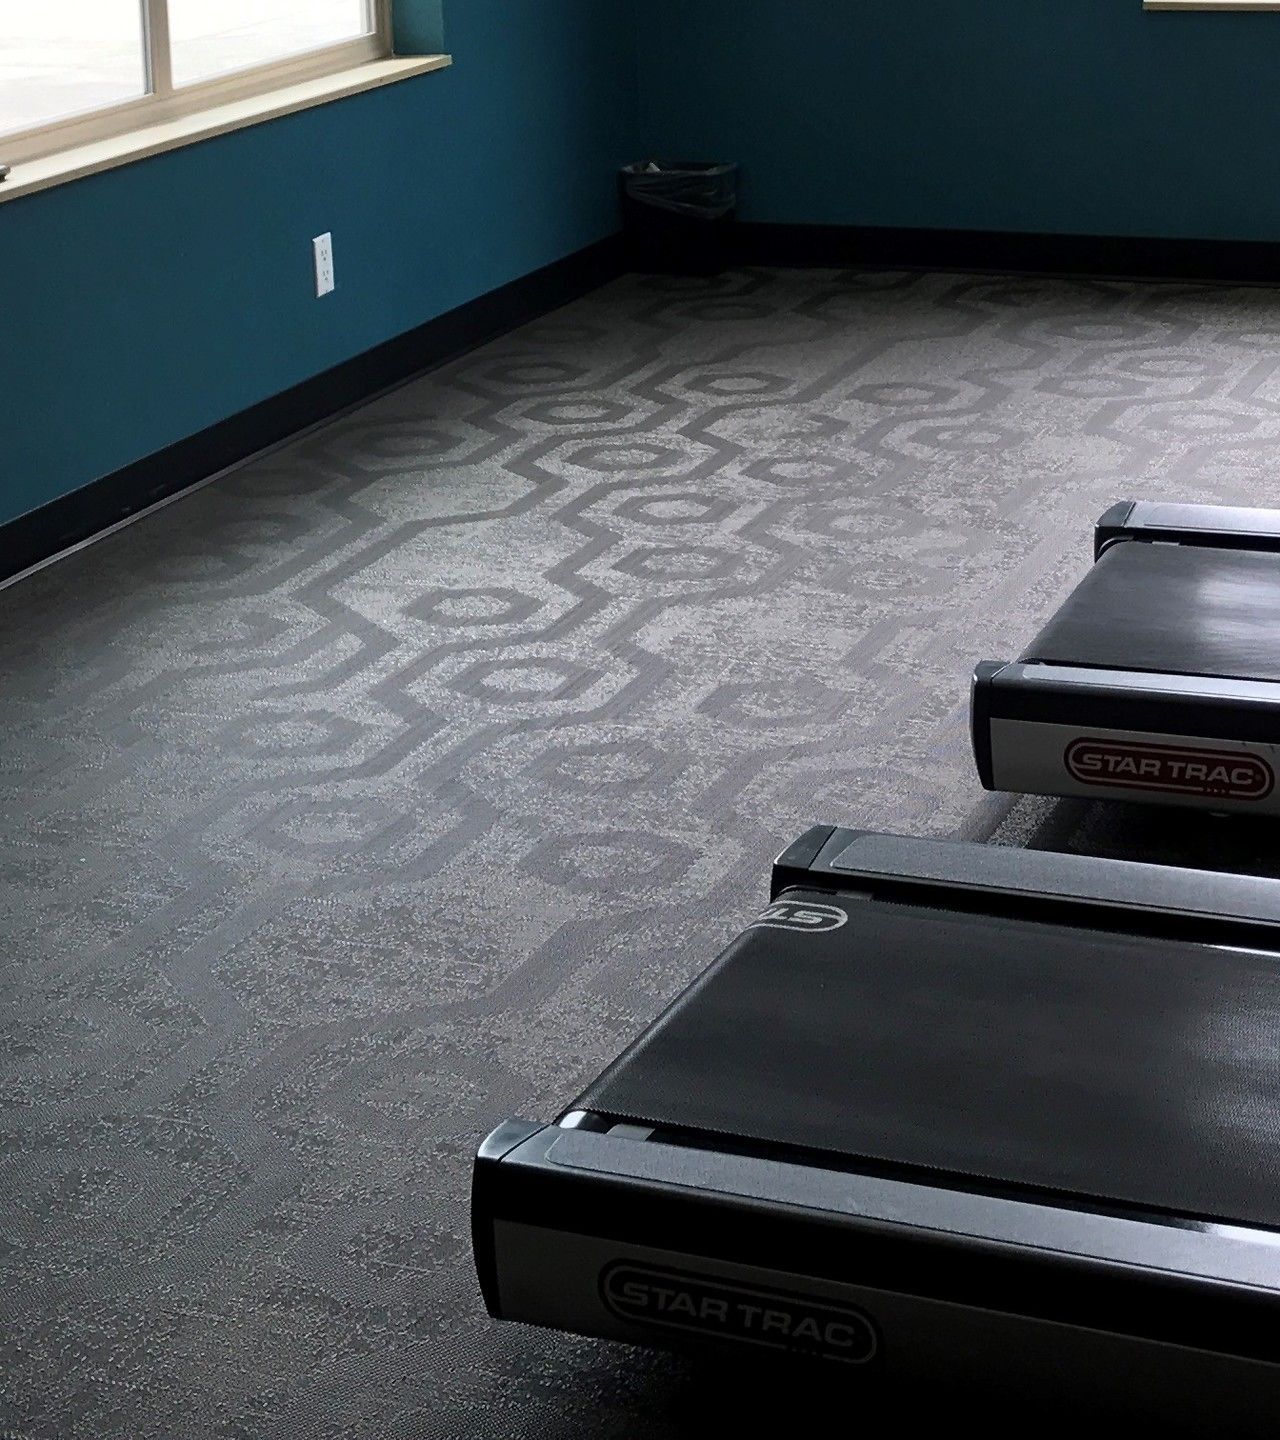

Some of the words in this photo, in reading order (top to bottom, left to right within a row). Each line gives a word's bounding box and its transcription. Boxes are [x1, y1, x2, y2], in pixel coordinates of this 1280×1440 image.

[1077, 753, 1162, 777] STAR
[1167, 761, 1255, 785] TRAC
[618, 1282, 729, 1324] STAR
[737, 1304, 856, 1347] TRAC
